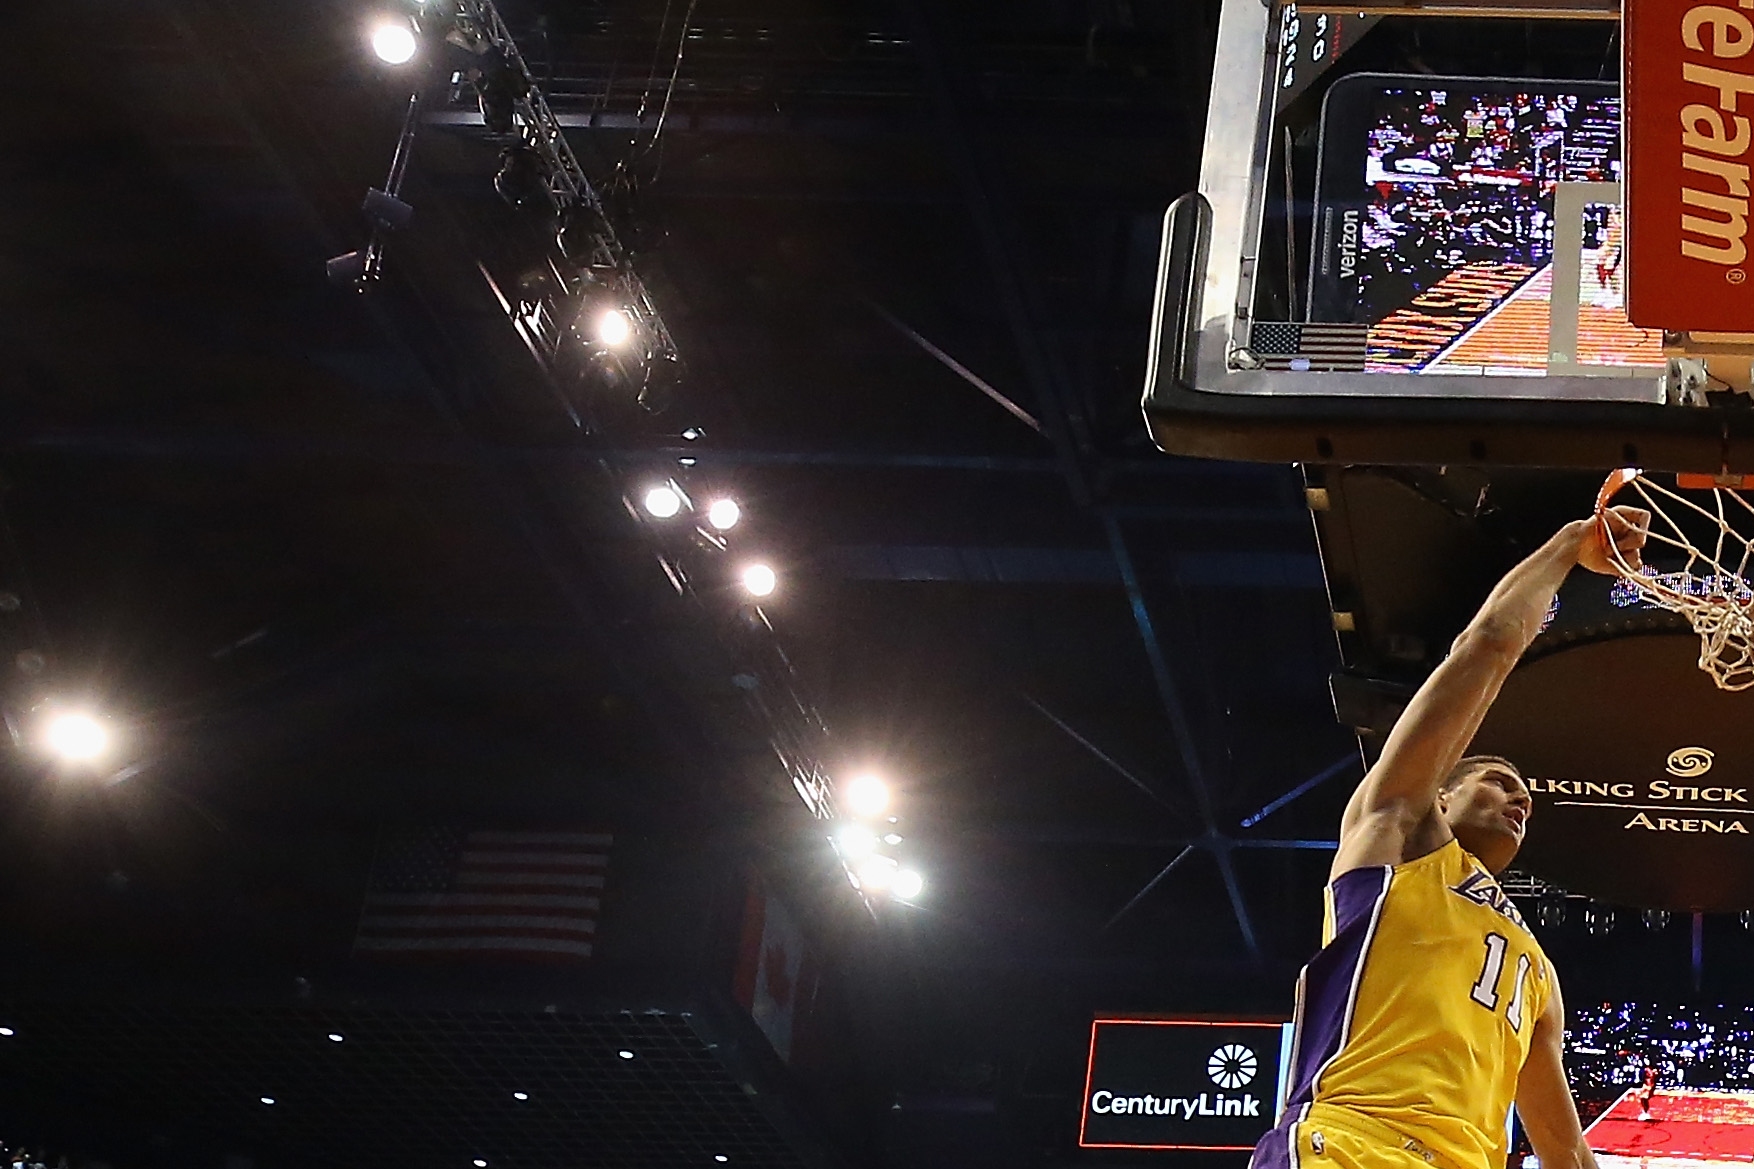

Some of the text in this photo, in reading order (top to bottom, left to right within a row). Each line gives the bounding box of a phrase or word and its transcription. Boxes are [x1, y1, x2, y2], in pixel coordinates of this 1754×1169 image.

[1340, 209, 1360, 280] verizon
[1526, 777, 1634, 799] LKING
[1648, 780, 1750, 803] STICK
[1624, 812, 1750, 835] ARENA
[1470, 931, 1531, 1035] 11
[1091, 1090, 1260, 1121] CenturyLink
